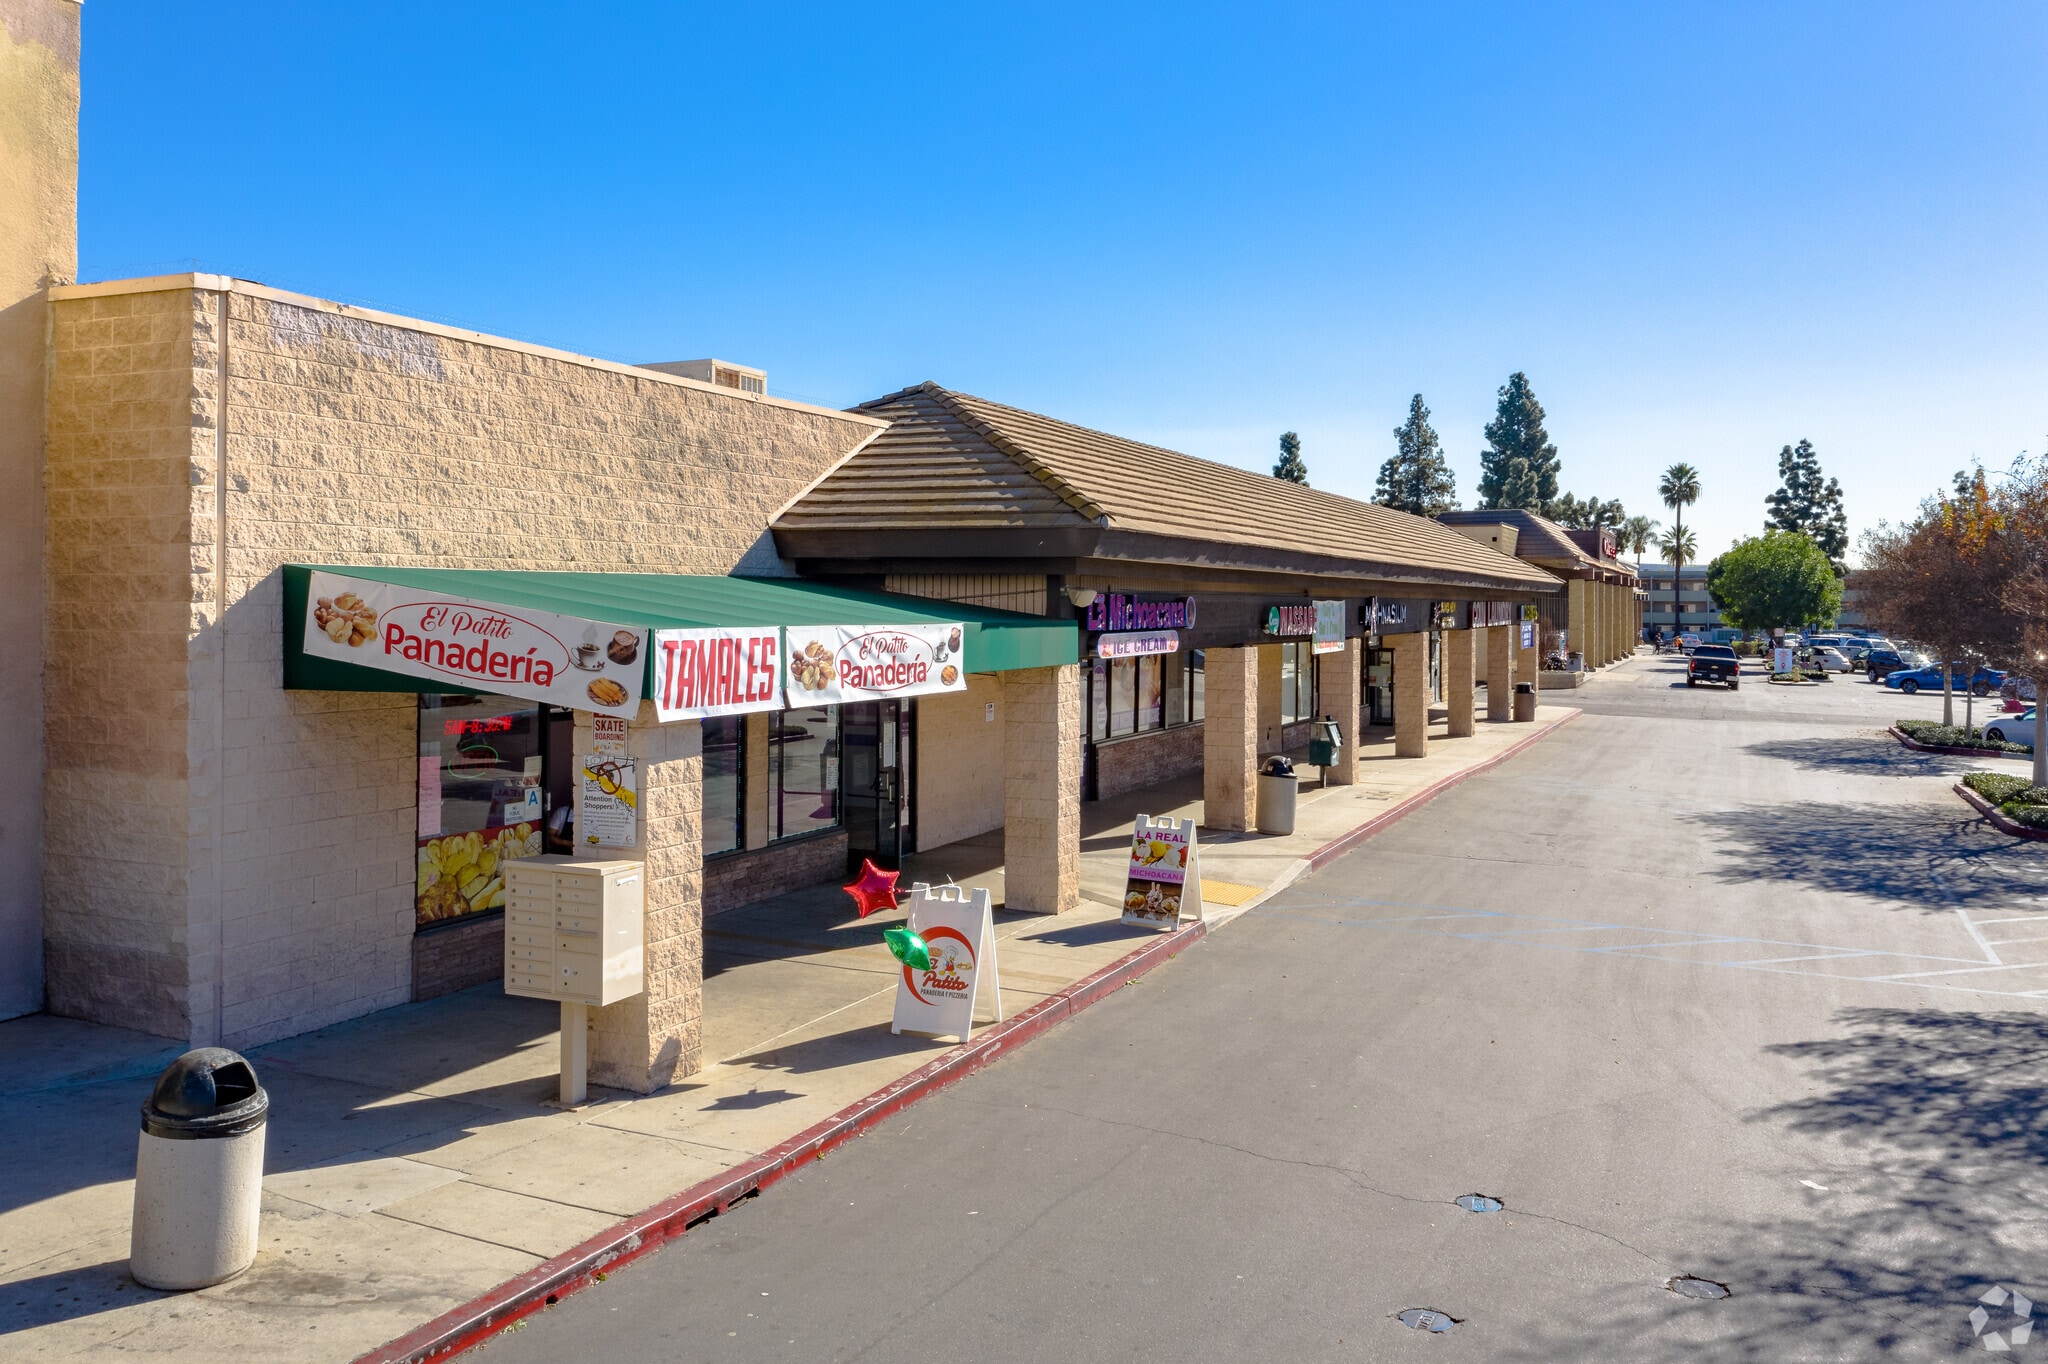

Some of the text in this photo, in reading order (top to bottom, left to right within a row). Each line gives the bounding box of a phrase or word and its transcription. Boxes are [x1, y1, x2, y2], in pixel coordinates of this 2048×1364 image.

[1109, 594, 1185, 630] Michoacana
[419, 606, 514, 640] El Patito
[859, 637, 910, 659] El Patito
[1112, 636, 1168, 654] ICE CREAM
[384, 623, 555, 687] Panadería
[662, 637, 776, 710] TAMALES
[839, 654, 927, 689] Panadería
[595, 720, 624, 732] SKATE
[595, 733, 624, 741] BOARDING
[528, 790, 538, 806] A
[584, 795, 613, 803] Attention
[584, 802, 615, 811] Shoppers!
[1136, 830, 1187, 843] LA REAL
[1130, 869, 1184, 881] MICHOACANA
[923, 971, 969, 990] Patito
